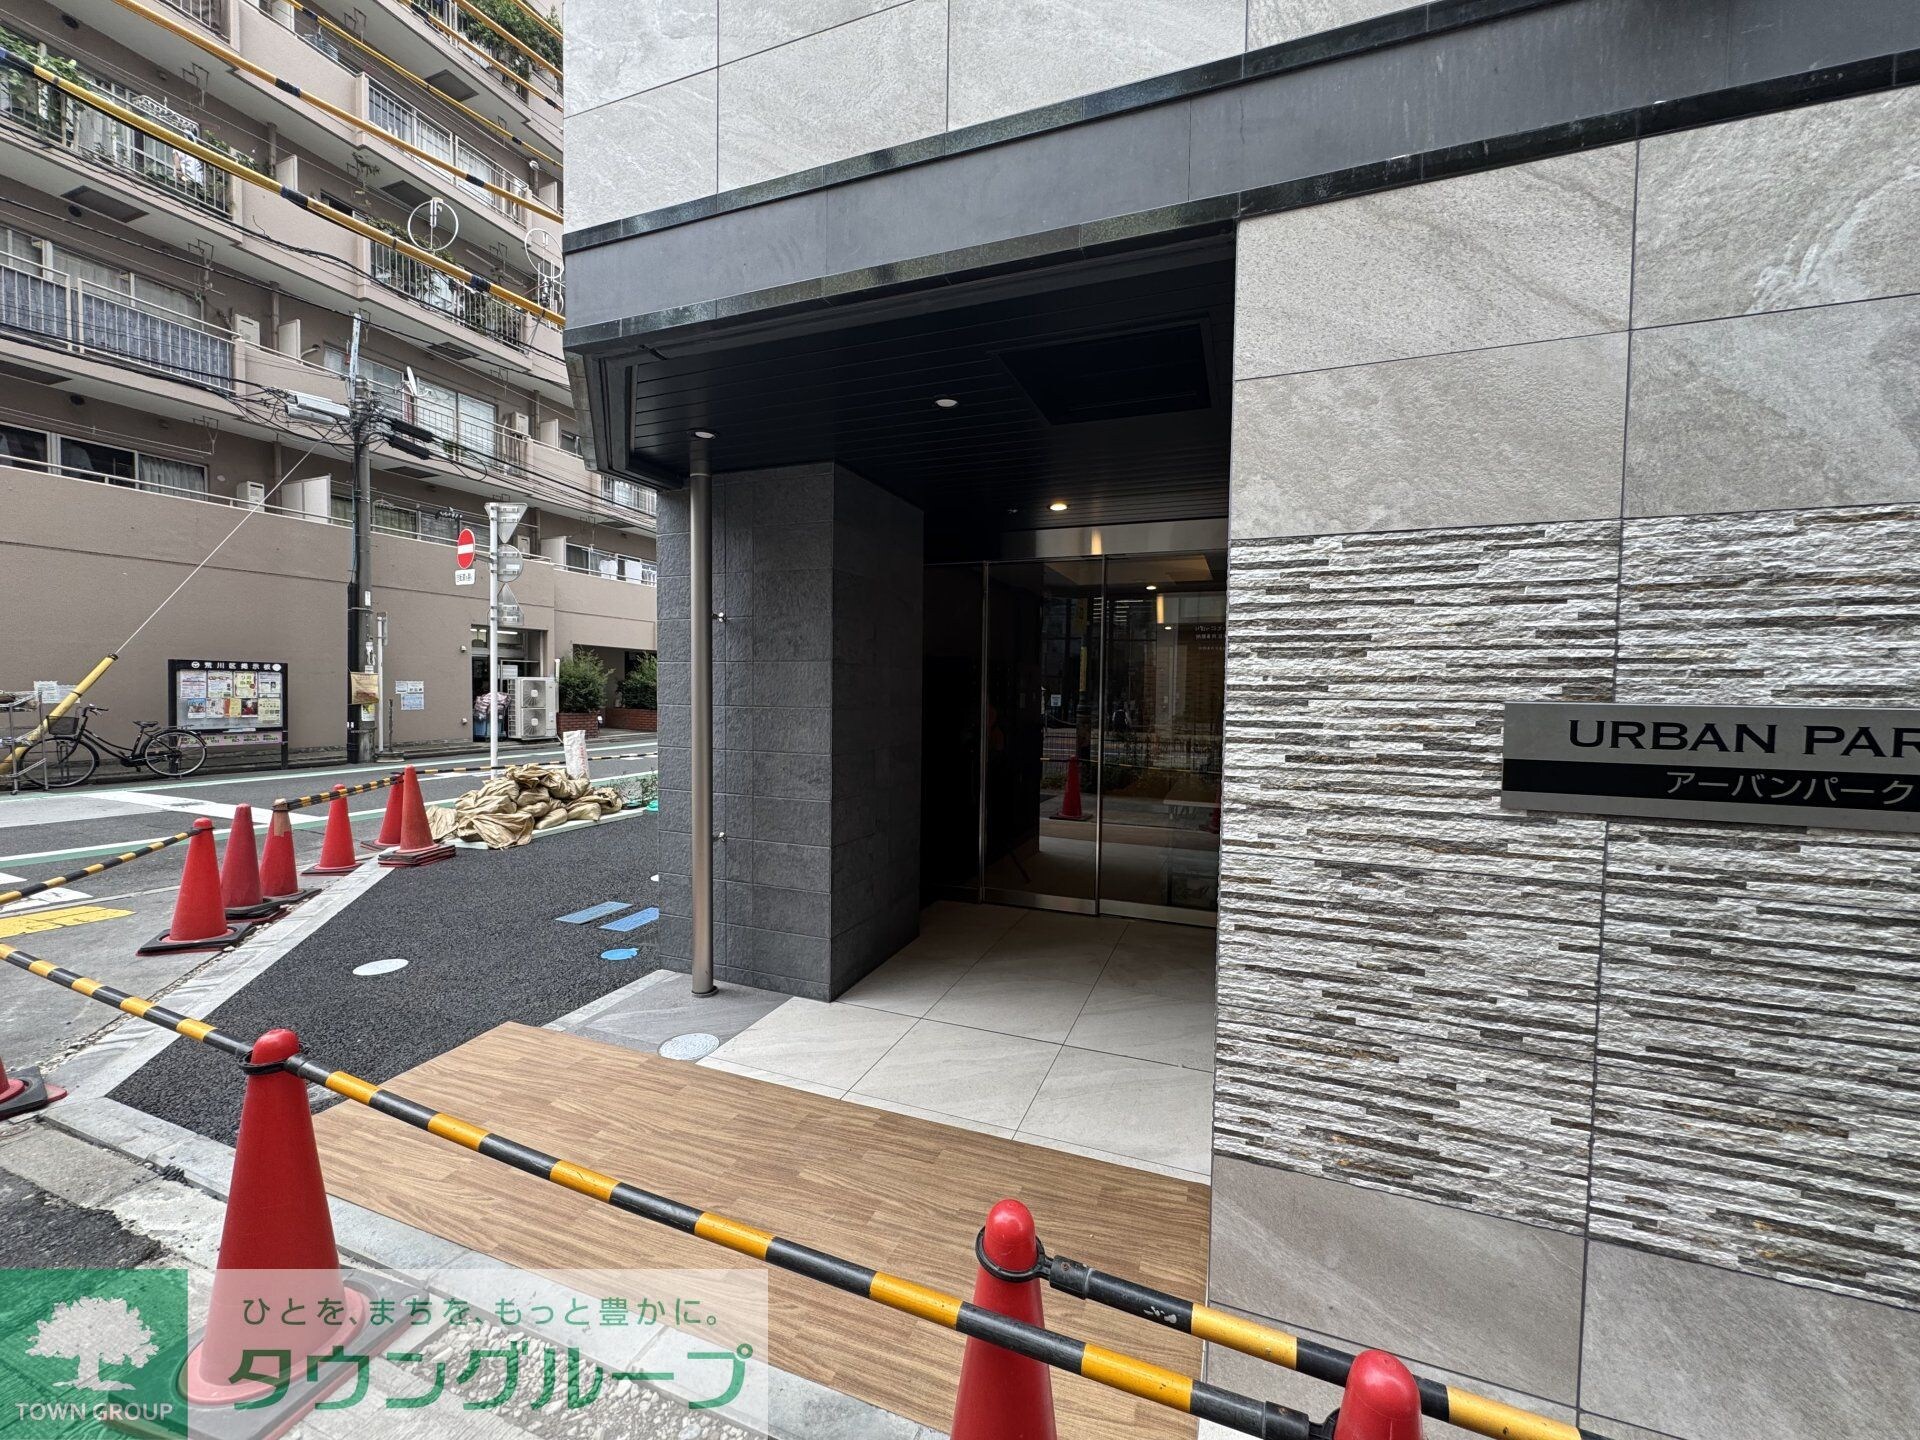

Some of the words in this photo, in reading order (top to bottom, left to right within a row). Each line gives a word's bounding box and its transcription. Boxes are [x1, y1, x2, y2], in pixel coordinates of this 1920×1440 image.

[1568, 719, 1777, 754] URBAN
[1666, 772, 1914, 805] アーバンパーク
